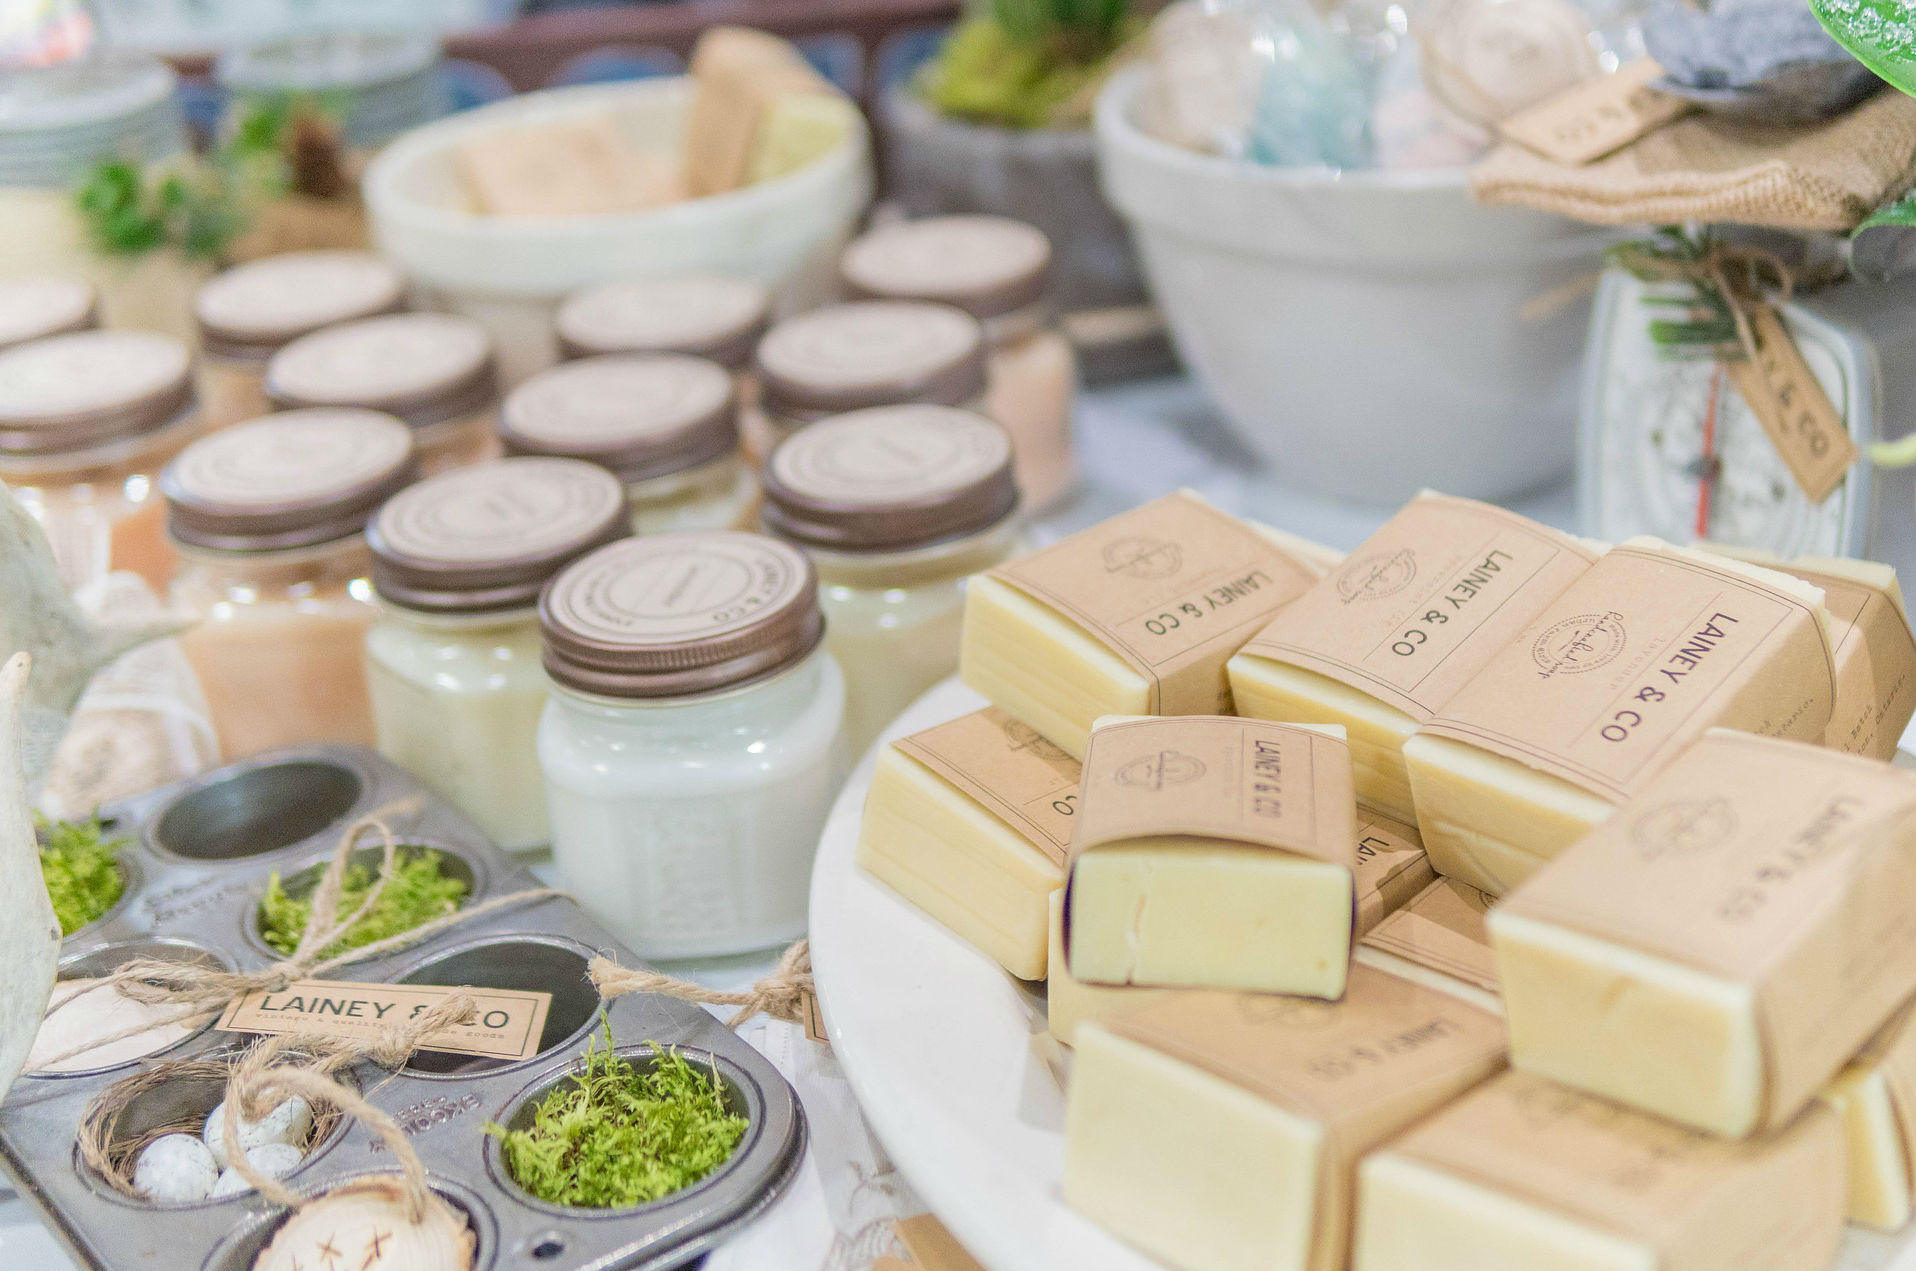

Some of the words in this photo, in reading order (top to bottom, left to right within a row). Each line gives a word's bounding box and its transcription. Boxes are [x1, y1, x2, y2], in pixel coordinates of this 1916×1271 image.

[1202, 569, 1274, 612] LAINEY
[1443, 549, 1514, 611] LAINEY
[1145, 611, 1181, 637] CO
[1178, 602, 1203, 620] &
[1426, 608, 1450, 627] &
[1391, 628, 1428, 657] CO
[1660, 612, 1739, 685] LAINEY
[1634, 686, 1666, 704] &
[1600, 708, 1644, 743] CO
[1255, 739, 1283, 781] LAINEY
[259, 995, 396, 1019] LAINEY
